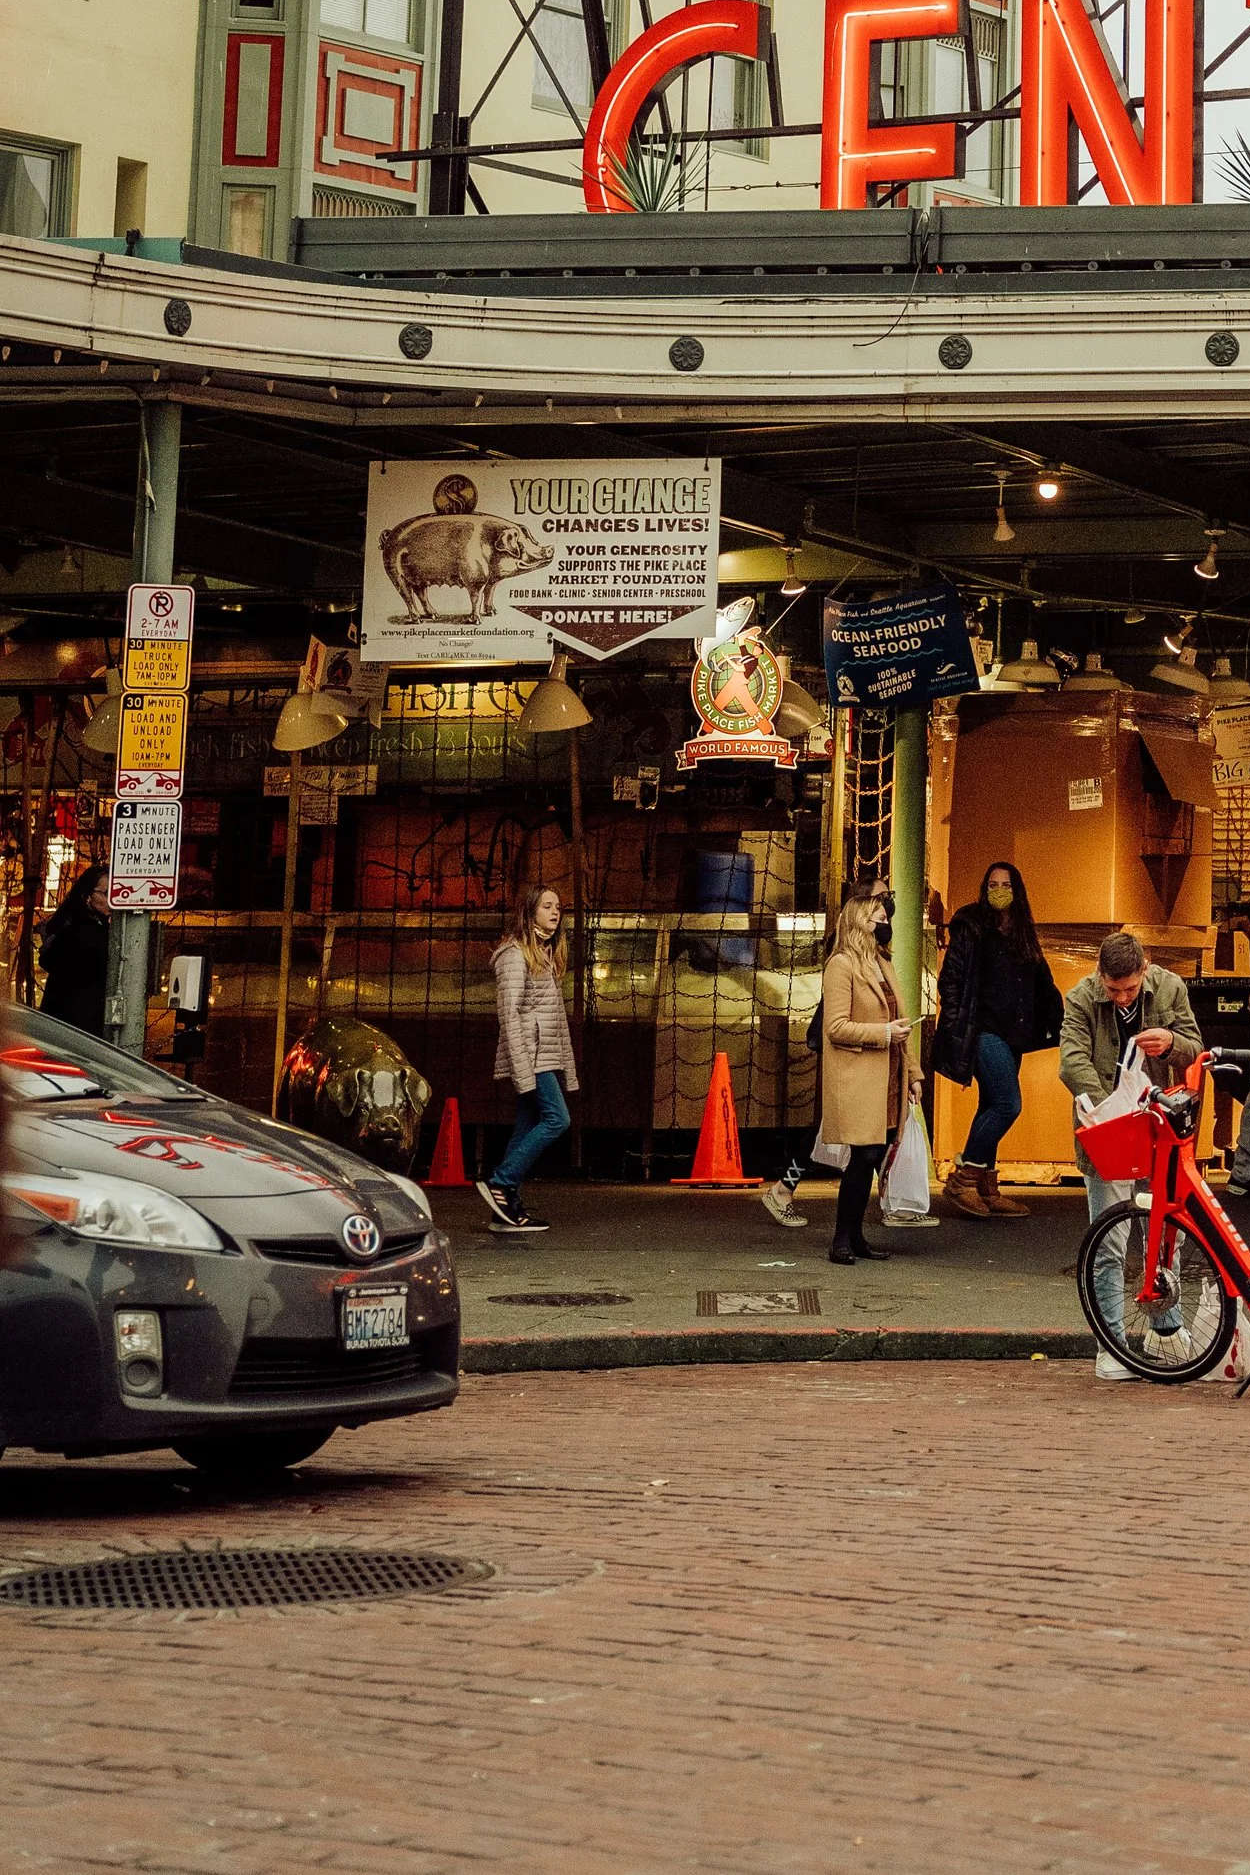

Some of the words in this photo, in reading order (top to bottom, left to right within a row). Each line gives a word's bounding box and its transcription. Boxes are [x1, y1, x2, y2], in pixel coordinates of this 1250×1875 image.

[510, 478, 589, 514] YOUR
[593, 478, 711, 514] CHANGE
[541, 518, 641, 533] CHANGES
[644, 518, 710, 533] LIVES!
[565, 545, 607, 556] YOUR
[610, 545, 708, 556] GENEROSITY
[558, 560, 617, 572] SUPPORTS
[620, 560, 641, 571] THE
[644, 560, 669, 571] PIKE
[672, 559, 707, 571] PLACE
[548, 575, 609, 585] MARKET
[612, 575, 706, 585] FOUNDATION
[509, 589, 530, 599] FOOD
[531, 589, 553, 599] BANK
[559, 589, 586, 599] CLINIC
[592, 589, 622, 599] SENIOR
[623, 589, 653, 598] CENTER
[660, 589, 706, 598] PRESCHOOL
[870, 604, 894, 616] Seattle
[894, 598, 928, 611] Aquarium
[541, 610, 614, 623] DONATE
[619, 610, 672, 623] HERE!
[140, 619, 160, 629] 2-7
[163, 619, 179, 629] AM
[831, 614, 947, 643] OCEAN-FRIENDLY
[141, 629, 177, 637] EVERYDAY
[380, 627, 535, 639] www.pikeplacemarketfoundation.org
[129, 639, 143, 649] 30
[150, 643, 183, 651] MINUTE
[853, 637, 922, 658] SEAFOOD
[144, 651, 173, 661] TRUCK
[133, 662, 155, 671] LOAD
[158, 662, 180, 671] ONLY
[136, 671, 177, 681] 7AM-10PM
[877, 667, 898, 681] 100%
[696, 669, 708, 702] PIKE
[762, 659, 778, 712] MARKET
[867, 669, 917, 694] SUSTAINABLE
[878, 681, 913, 700] SEAFOOD
[126, 697, 142, 708] 30
[130, 713, 156, 723] LOAD
[159, 713, 178, 723] AND
[702, 703, 734, 731] PLACE
[738, 712, 764, 730] FISH
[133, 725, 172, 736] UNLOAD
[139, 739, 166, 749] ONLY
[688, 742, 732, 754] WORLD
[734, 742, 786, 755] FAMOUS
[131, 751, 171, 761] 10AM-7PM
[1213, 761, 1243, 781] BIG
[122, 804, 132, 817] 3
[118, 823, 175, 835] PASSENGER
[117, 837, 144, 849] LOAD
[149, 837, 175, 850] ONLY
[120, 853, 171, 865] 7PM-2AM
